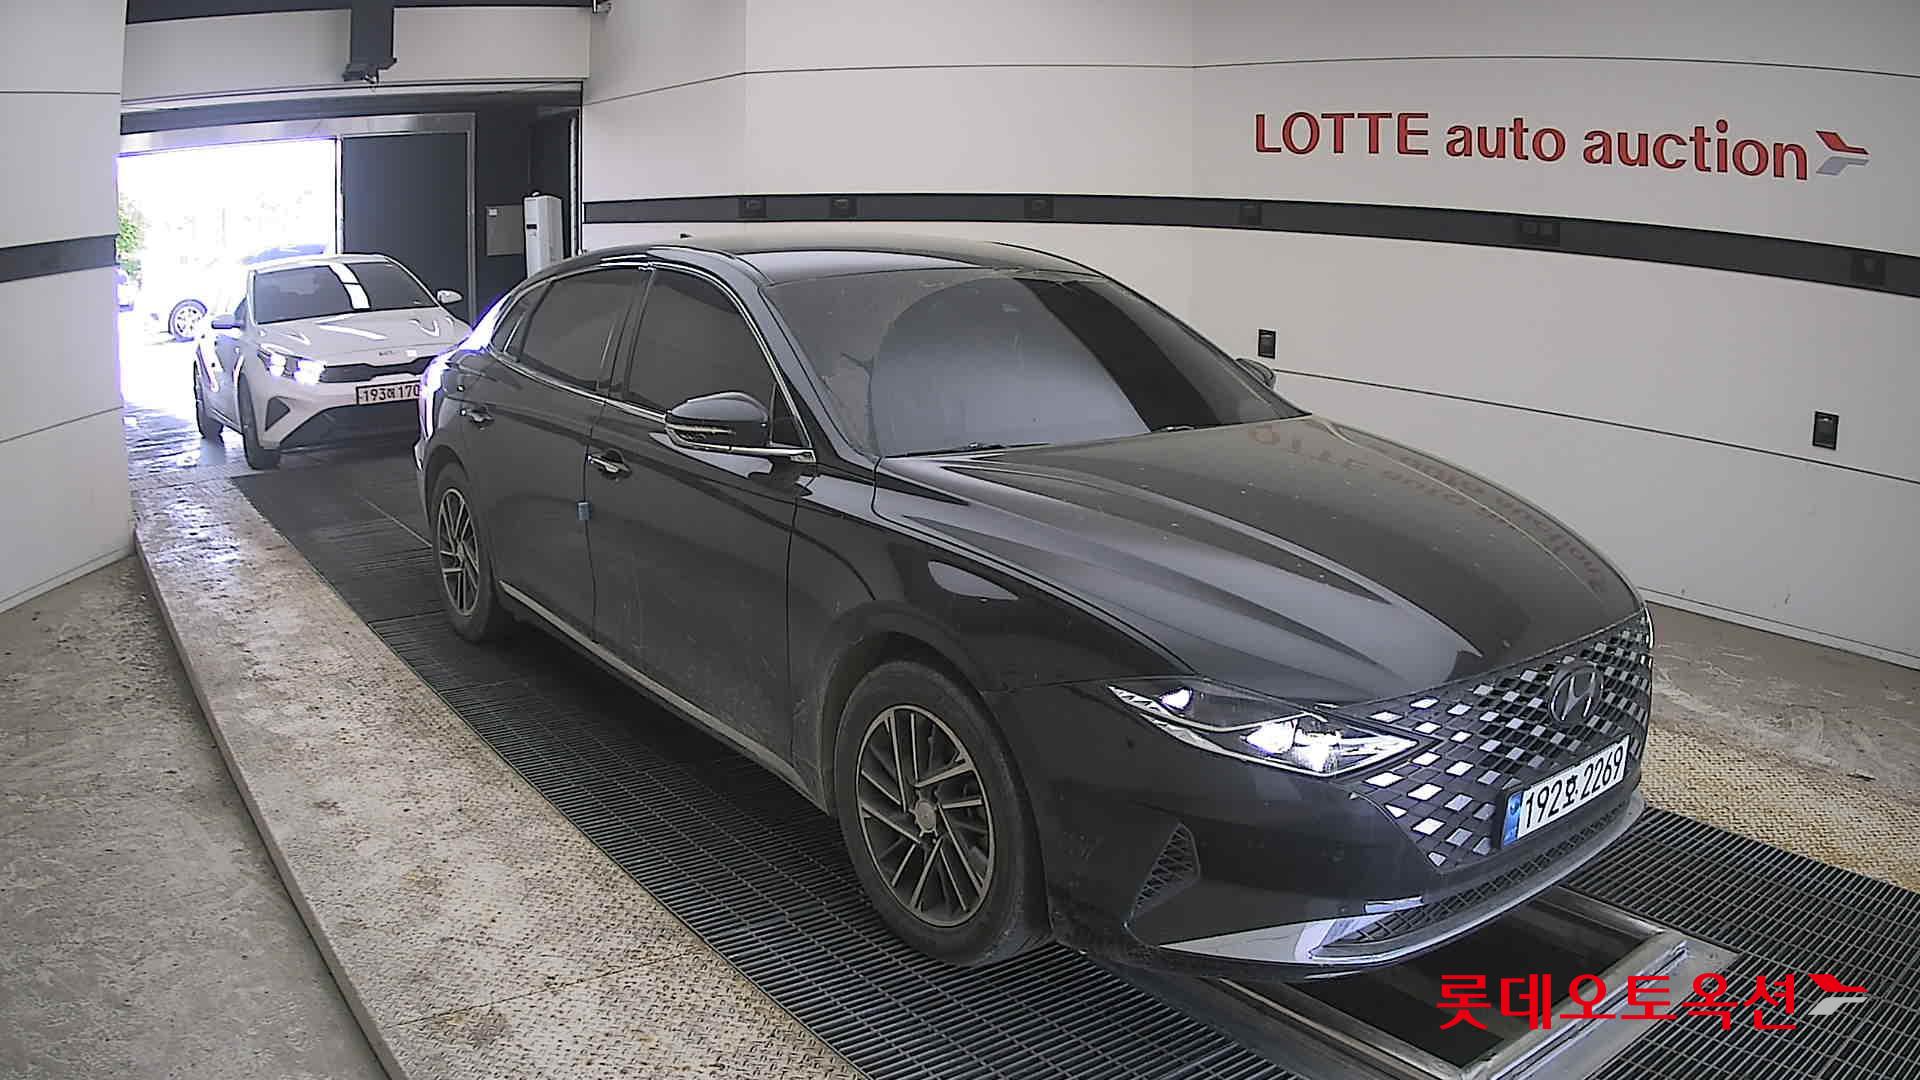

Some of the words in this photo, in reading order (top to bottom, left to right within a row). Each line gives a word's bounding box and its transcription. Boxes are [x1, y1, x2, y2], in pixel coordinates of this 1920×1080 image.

[1254, 111, 1429, 156] LOTTE
[1446, 117, 1567, 162] auto
[1583, 119, 1808, 180] auction
[1525, 775, 1578, 829] 192호
[1580, 744, 1624, 801] 2269
